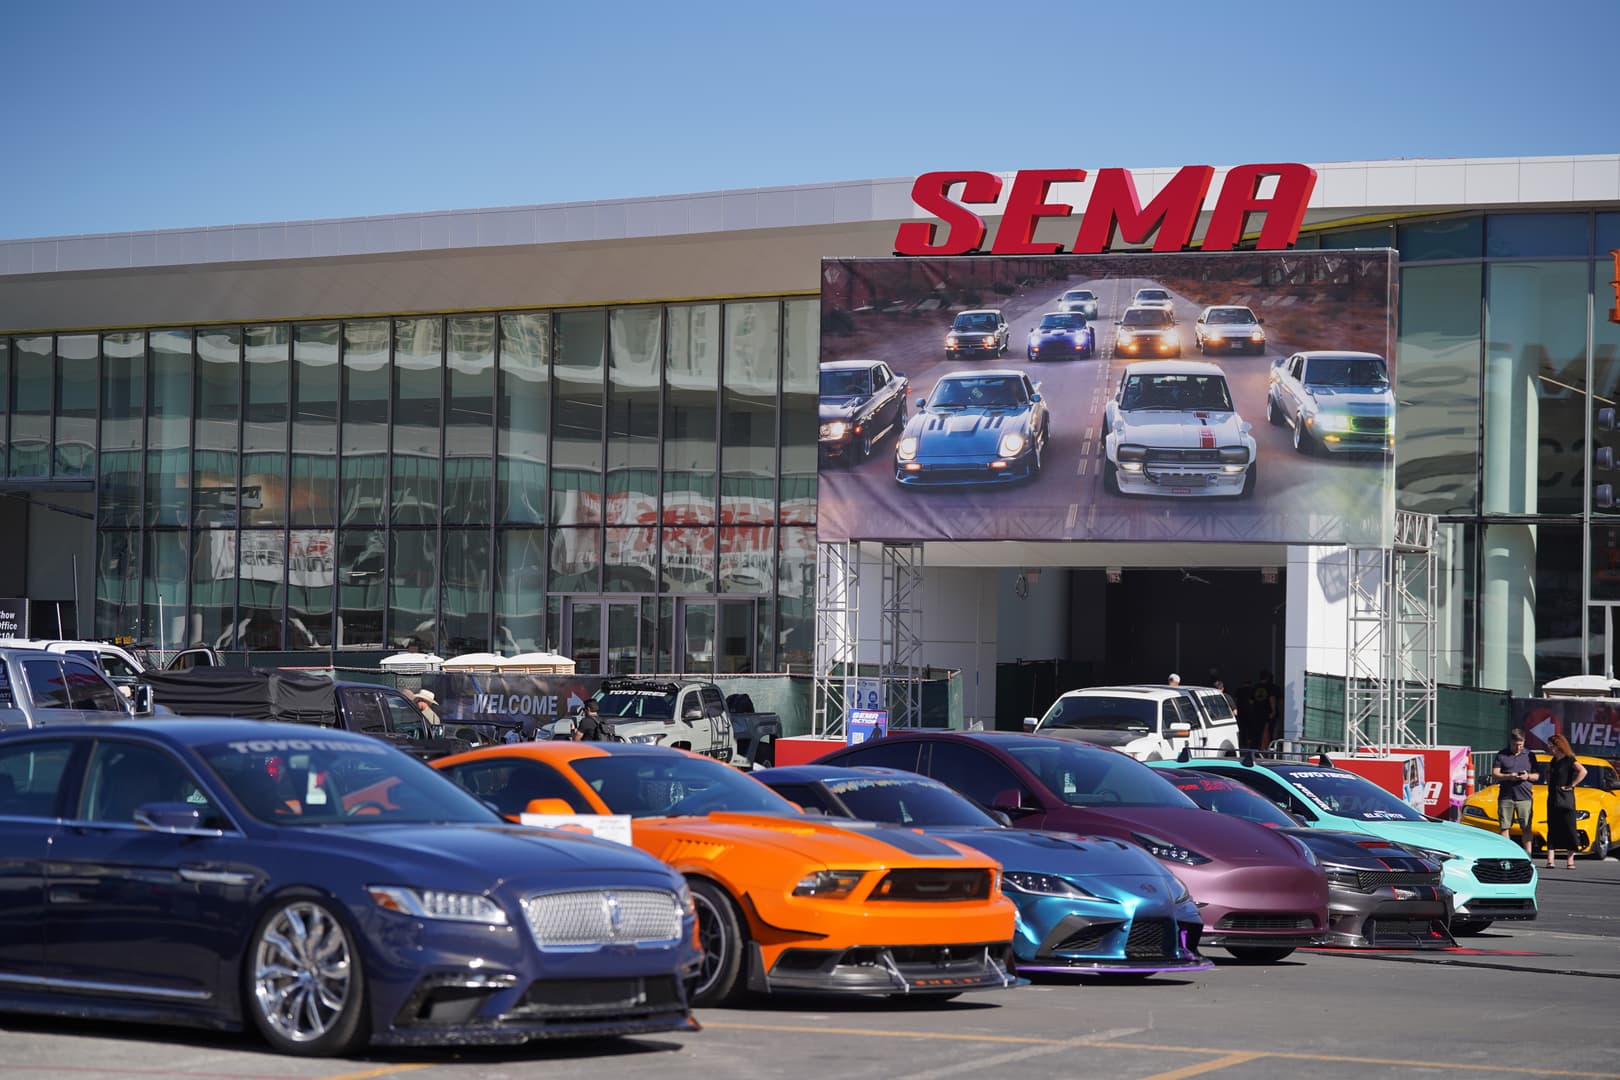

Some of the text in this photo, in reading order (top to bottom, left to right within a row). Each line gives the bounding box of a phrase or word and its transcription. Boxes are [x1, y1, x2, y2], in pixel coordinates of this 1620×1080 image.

[894, 163, 1318, 255] SEMA
[0, 610, 15, 619] how
[0, 632, 15, 640] 104
[473, 693, 558, 716] WELCOME
[1570, 722, 1620, 747] WEL
